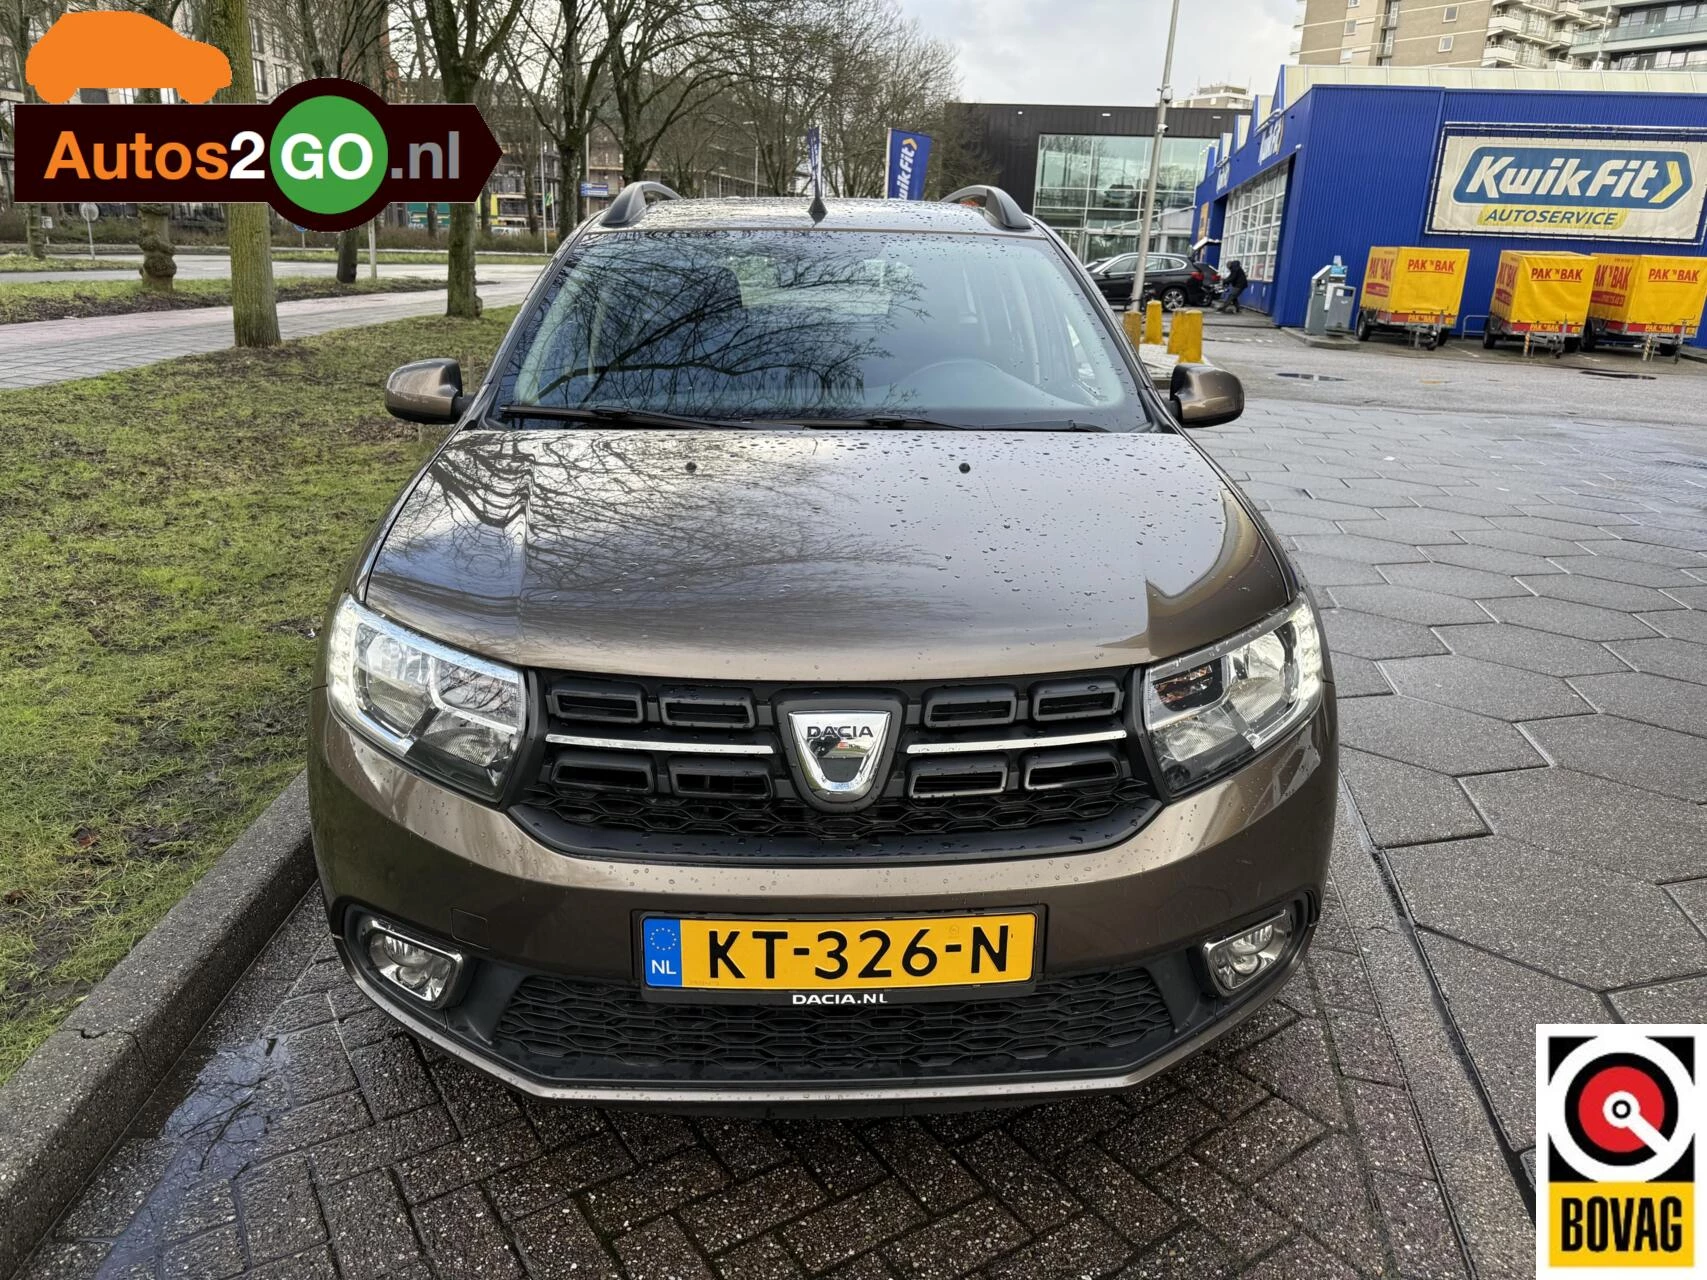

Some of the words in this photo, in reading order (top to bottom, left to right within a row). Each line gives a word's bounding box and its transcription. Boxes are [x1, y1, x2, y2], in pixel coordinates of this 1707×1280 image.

[896, 146, 916, 201] wikFit
[1484, 209, 1618, 225] AUTOSERVICE
[1408, 259, 1428, 270] PAK
[1435, 260, 1456, 272] BAK
[1531, 268, 1553, 279] PAK
[1560, 269, 1584, 280] BAK
[1648, 268, 1670, 280] PAK
[1677, 270, 1700, 282] BAK
[807, 725, 873, 739] DACIA
[709, 925, 1009, 980] KT-326-N
[651, 960, 677, 975] NL
[792, 993, 888, 1006] DACIA.NL
